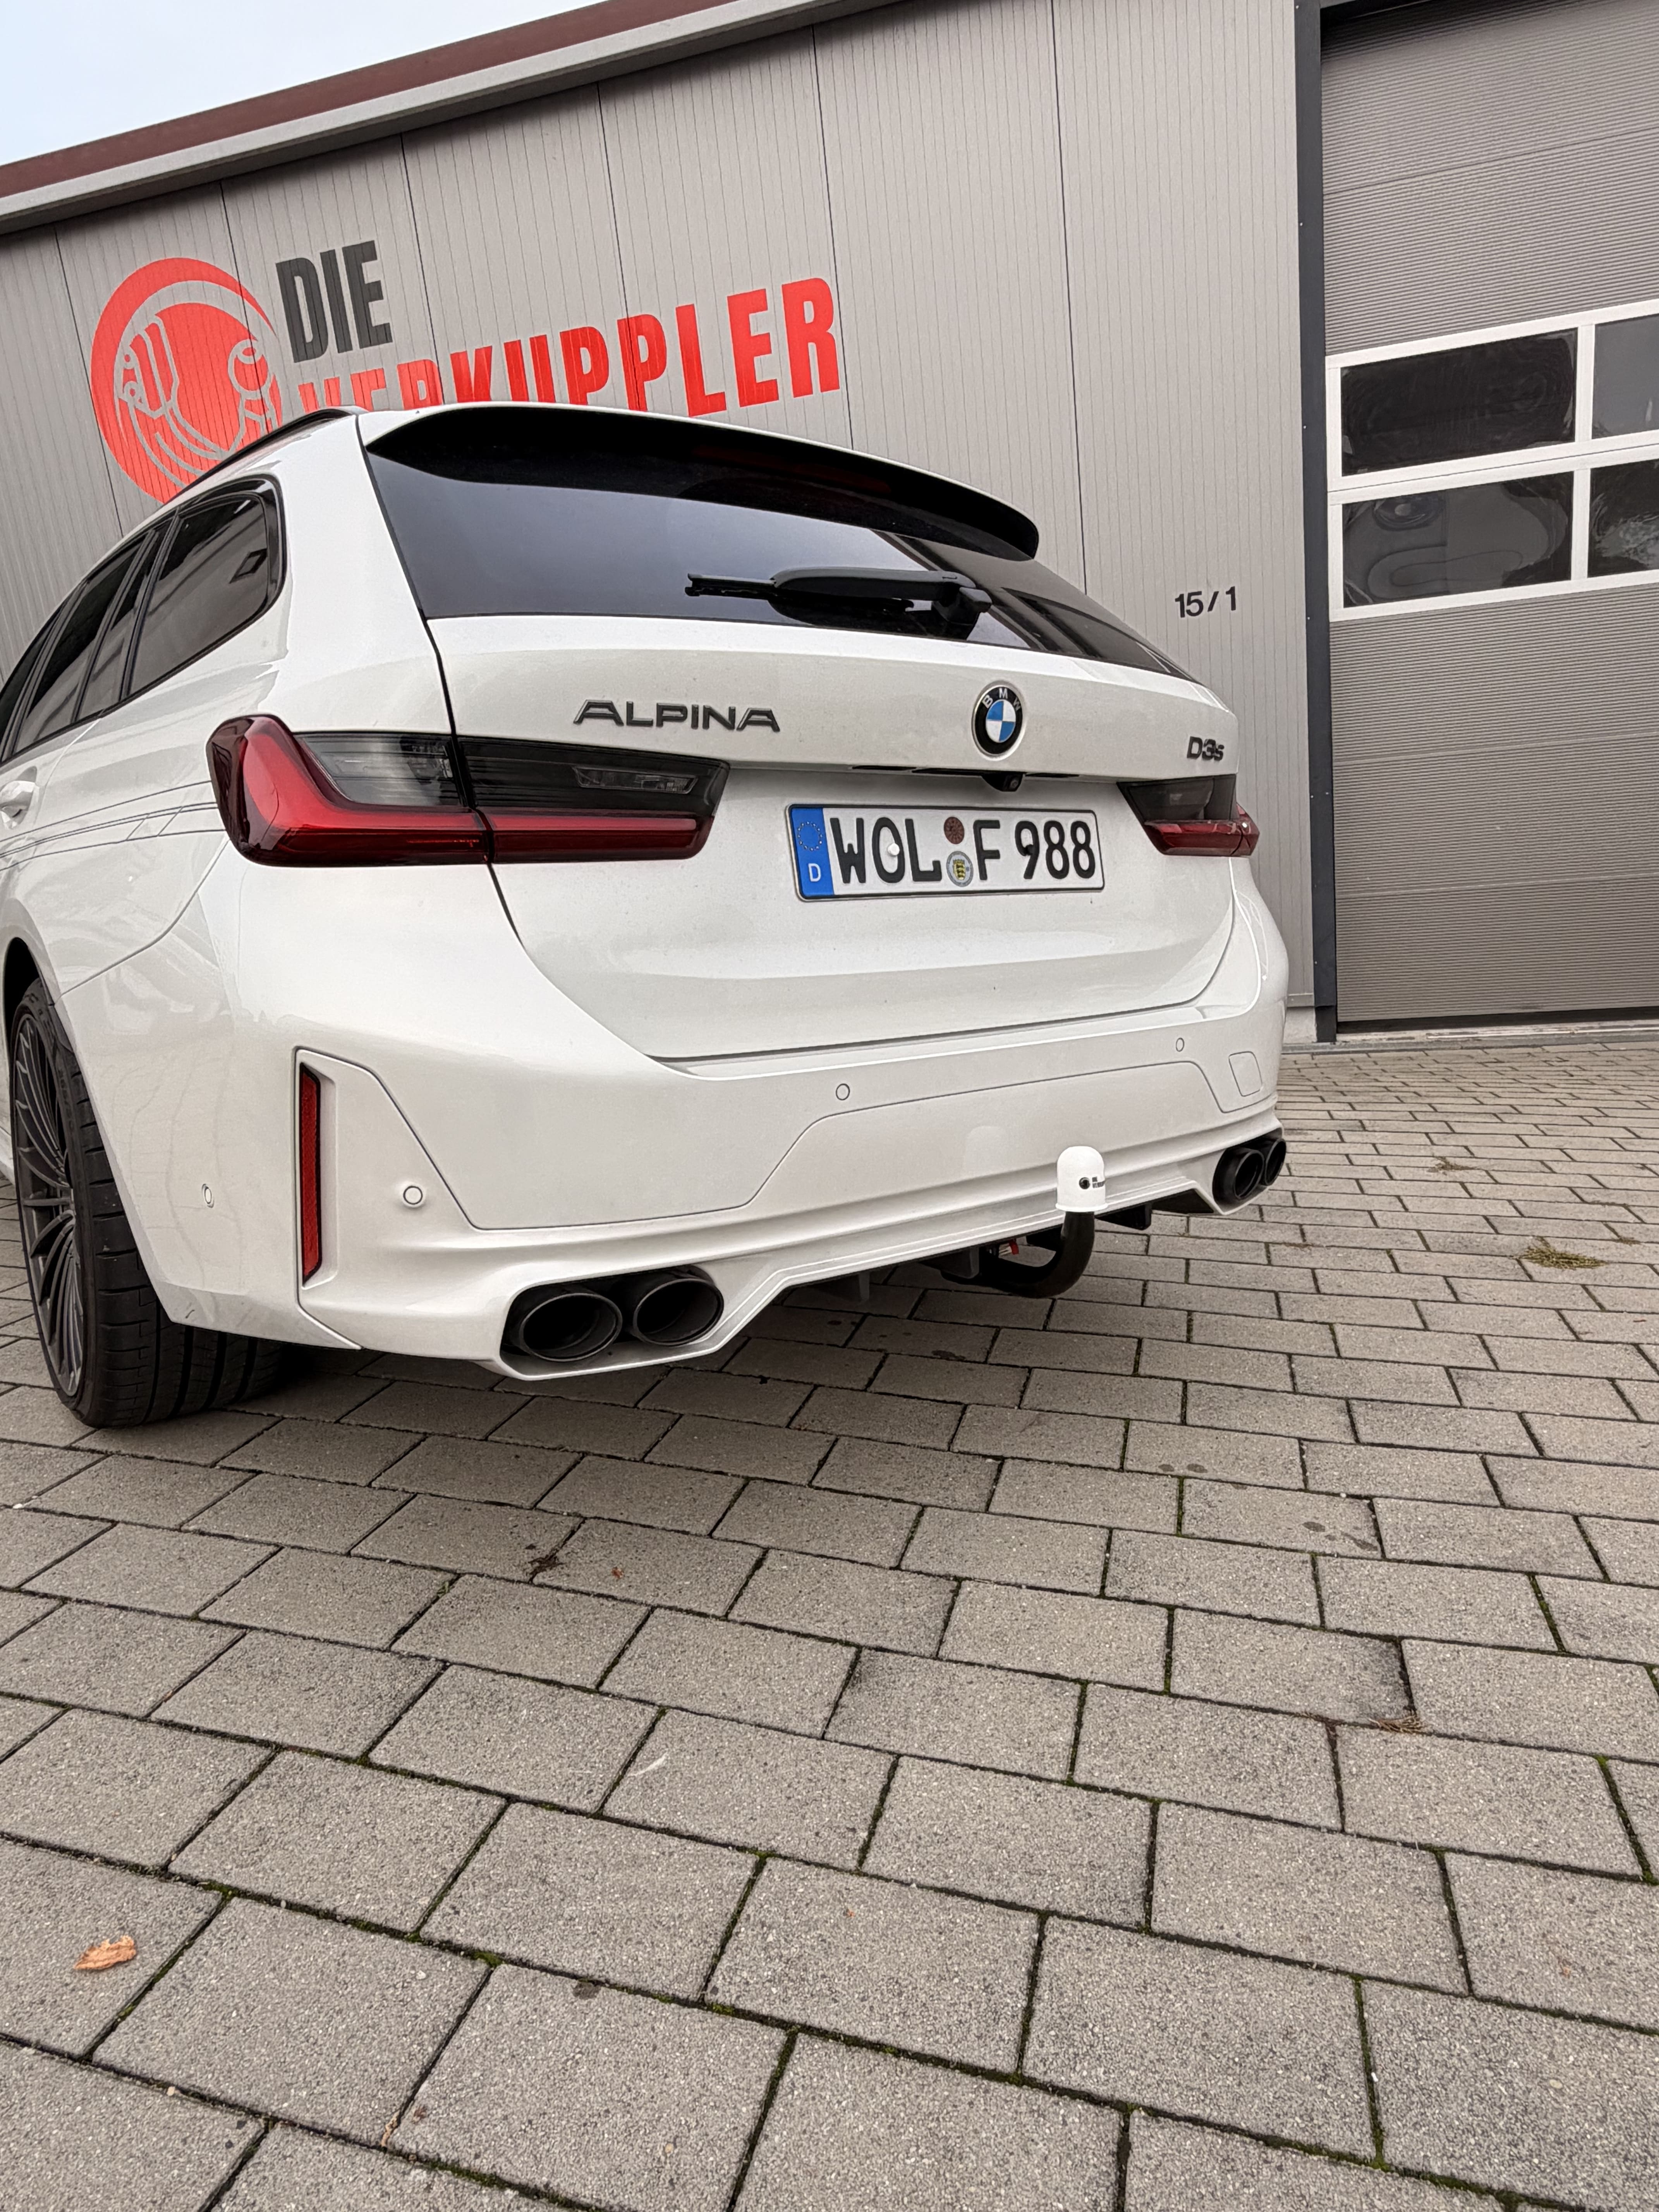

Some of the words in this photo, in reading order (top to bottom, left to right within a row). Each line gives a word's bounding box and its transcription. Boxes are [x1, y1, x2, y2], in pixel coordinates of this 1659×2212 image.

[276, 240, 392, 363] DIE
[298, 278, 840, 417] UPPLER
[573, 699, 780, 732] ALPINA
[982, 687, 1021, 711] BMW
[809, 863, 821, 882] D
[830, 817, 942, 883] WOL
[1015, 820, 1095, 879] 988
